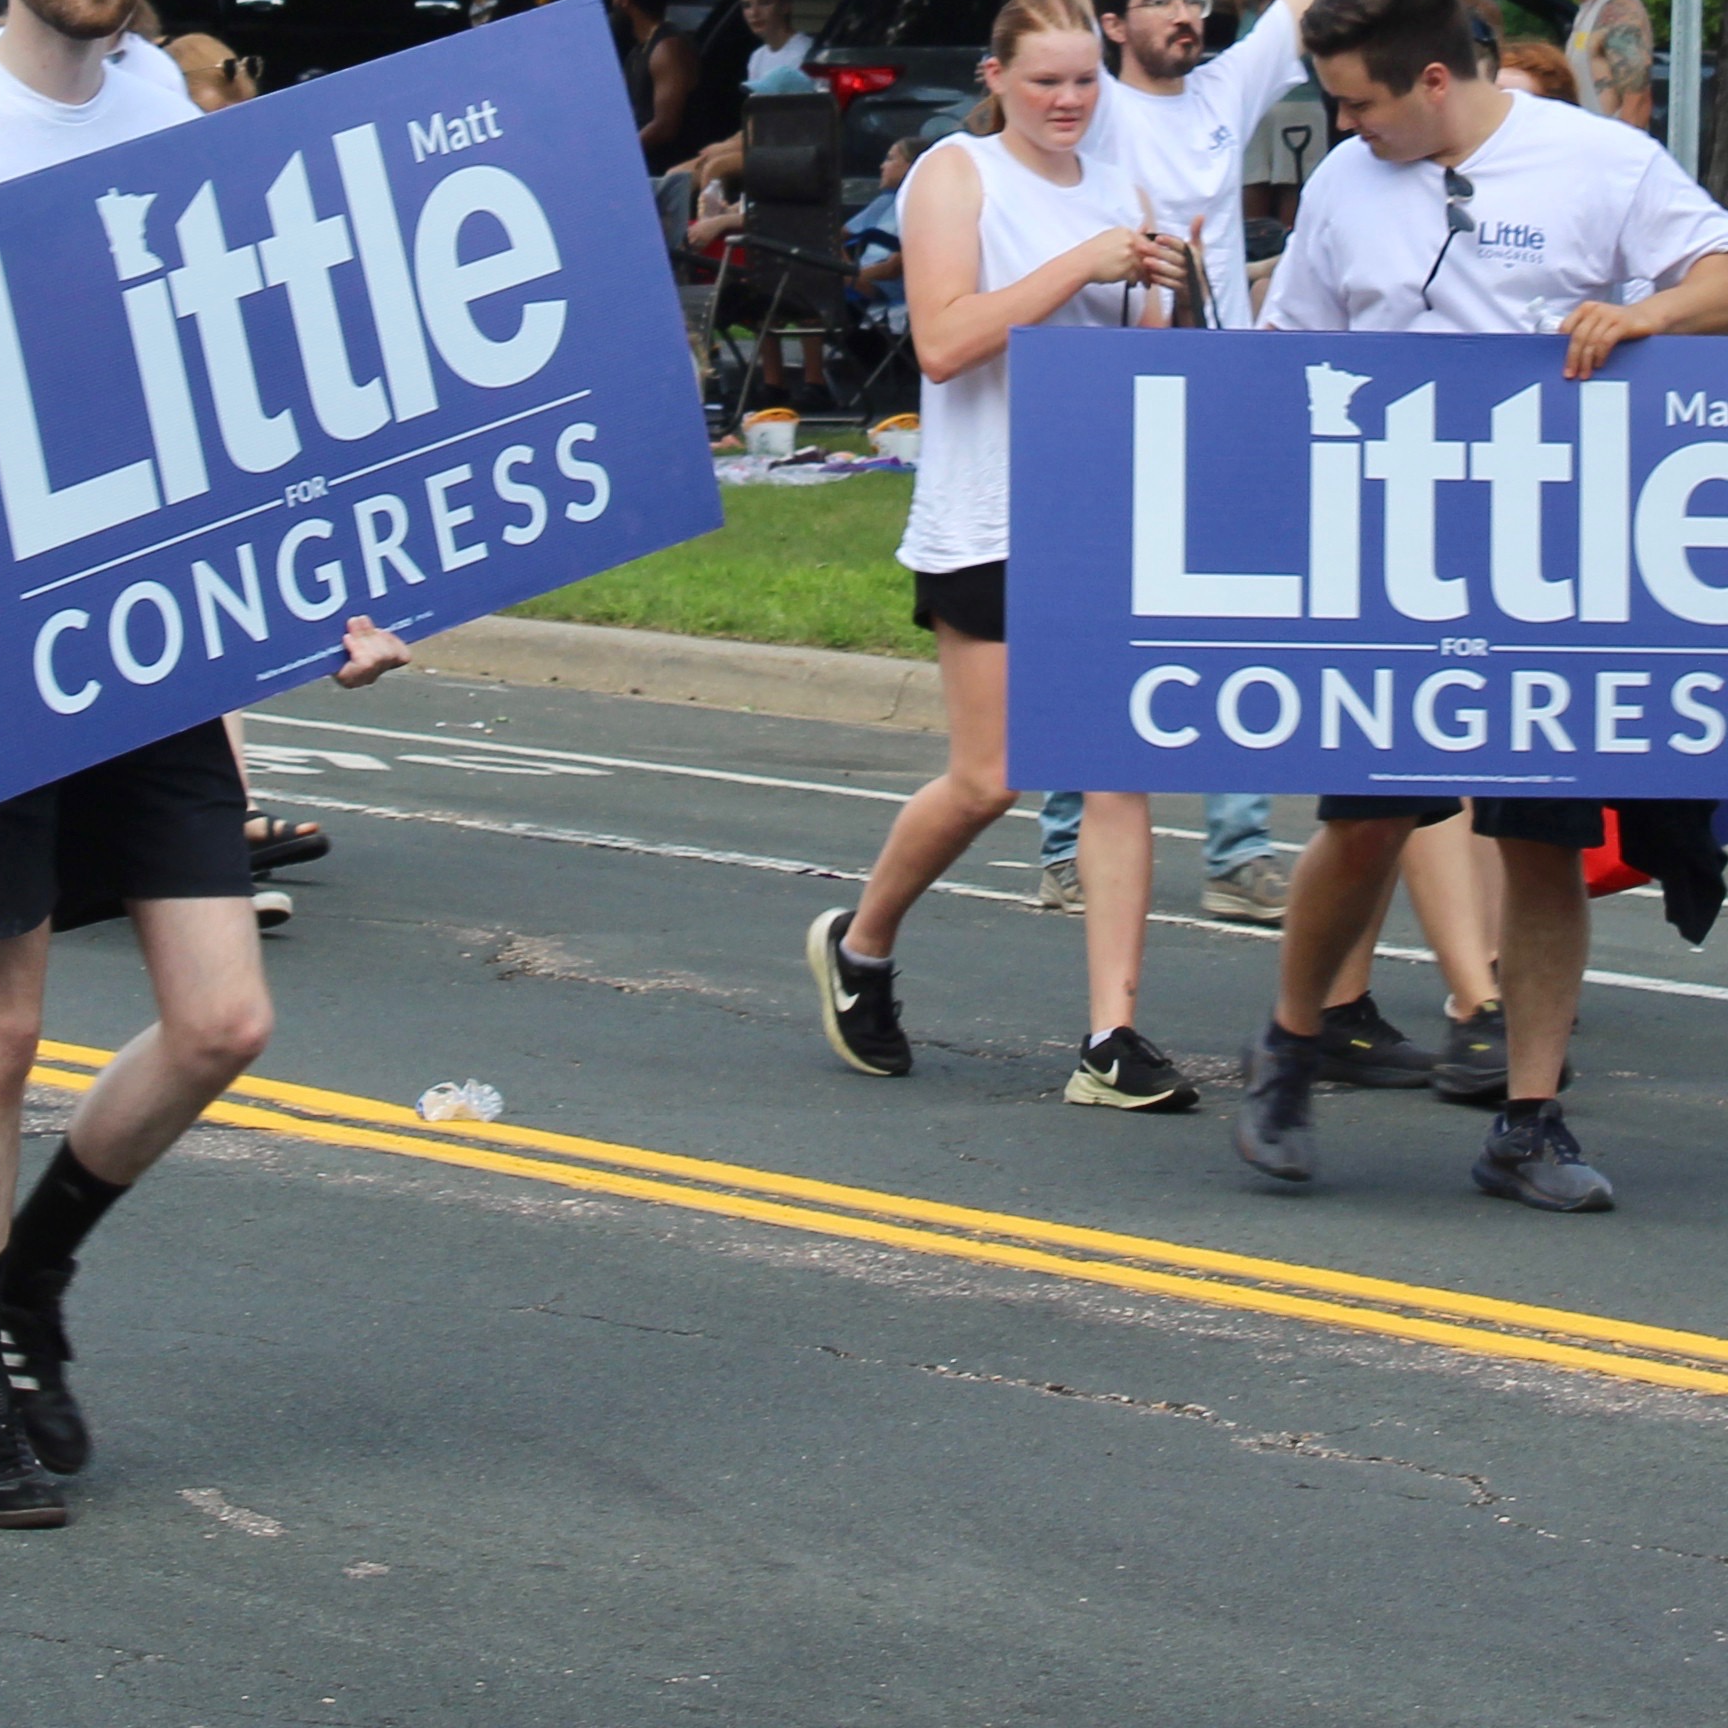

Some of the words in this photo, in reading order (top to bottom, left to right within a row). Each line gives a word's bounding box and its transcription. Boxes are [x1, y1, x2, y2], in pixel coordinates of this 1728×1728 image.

[406, 100, 504, 163] Matt
[1477, 221, 1546, 250] Little
[285, 475, 329, 508] FOR
[32, 422, 612, 716] CONGRESS
[1441, 637, 1489, 657] FOR
